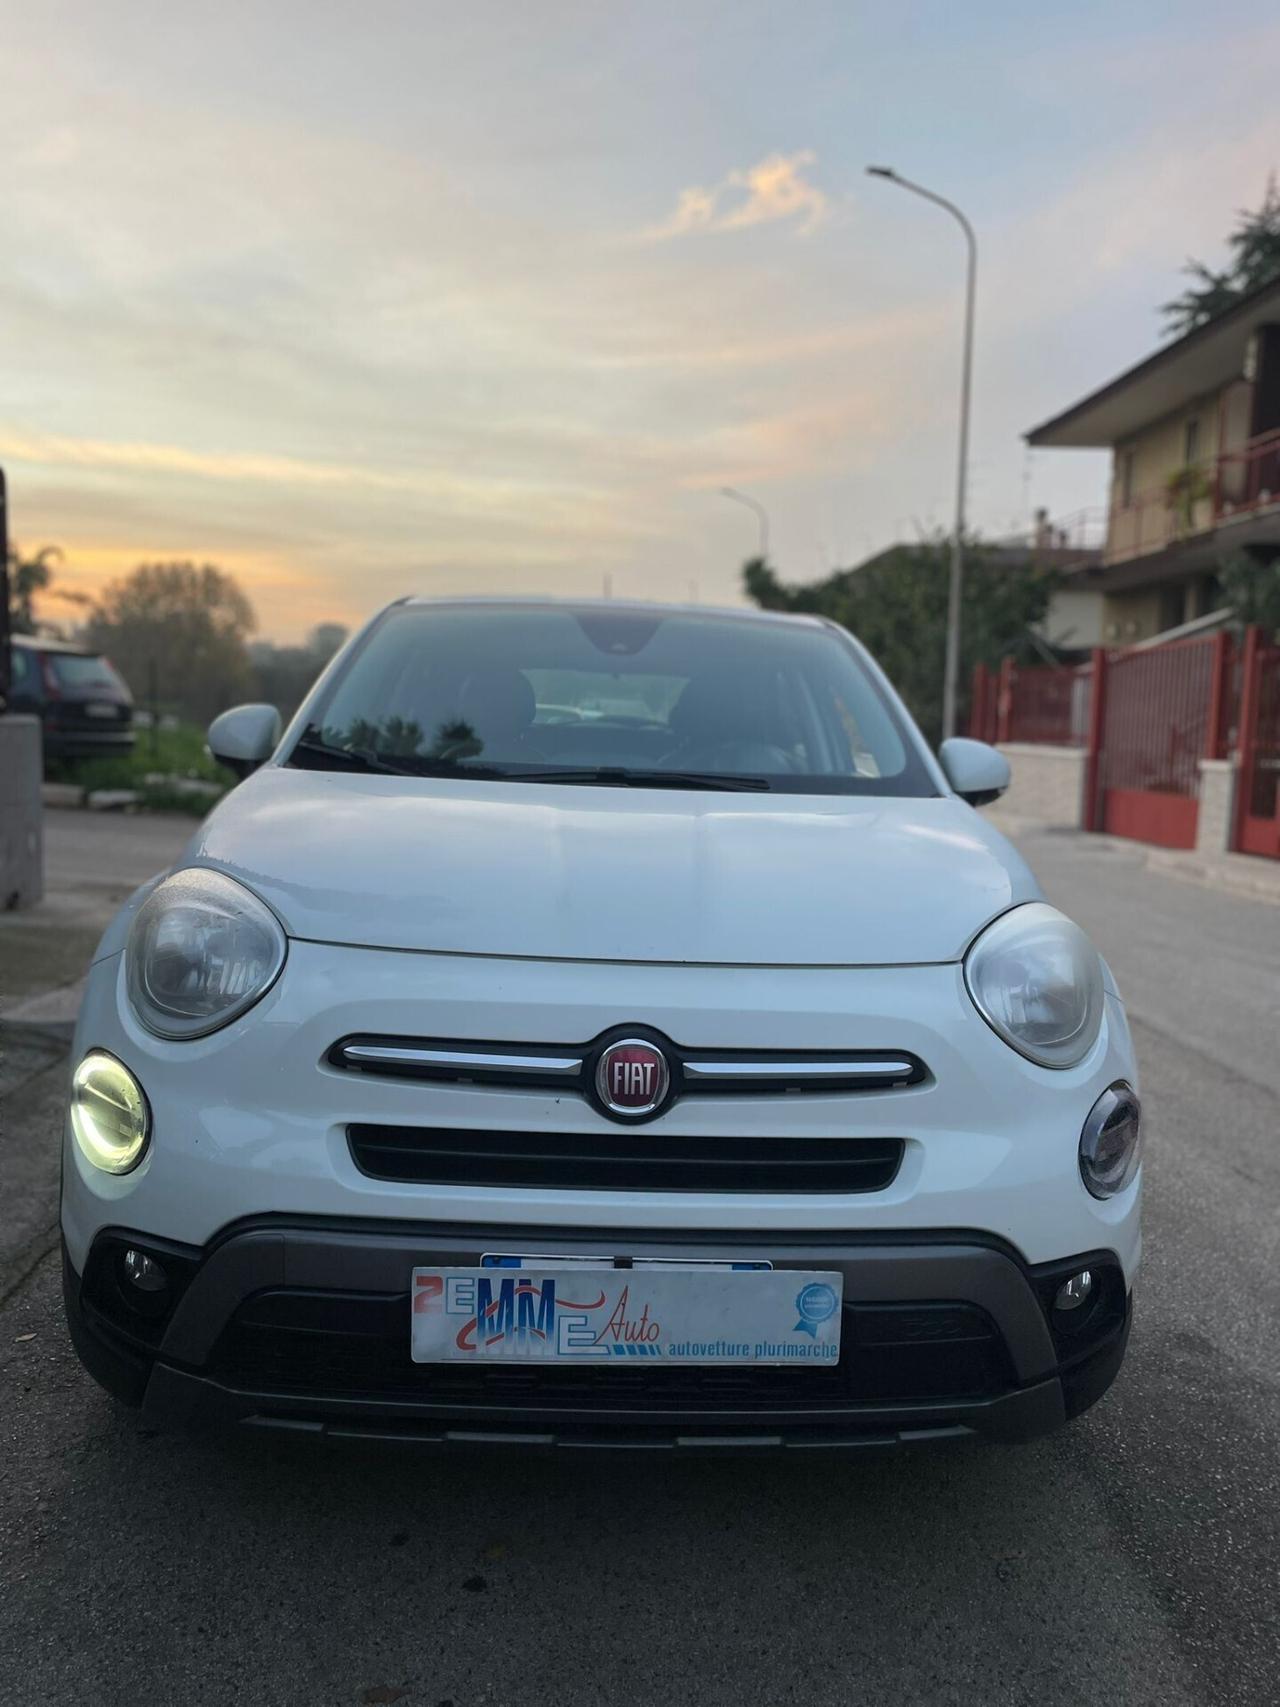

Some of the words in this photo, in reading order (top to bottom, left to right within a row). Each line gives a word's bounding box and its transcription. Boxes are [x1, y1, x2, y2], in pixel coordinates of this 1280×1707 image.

[613, 1062, 656, 1095] FIAT
[594, 1284, 660, 1343] Auto
[668, 1340, 750, 1356] autovetture
[754, 1340, 838, 1359] plurimarche
